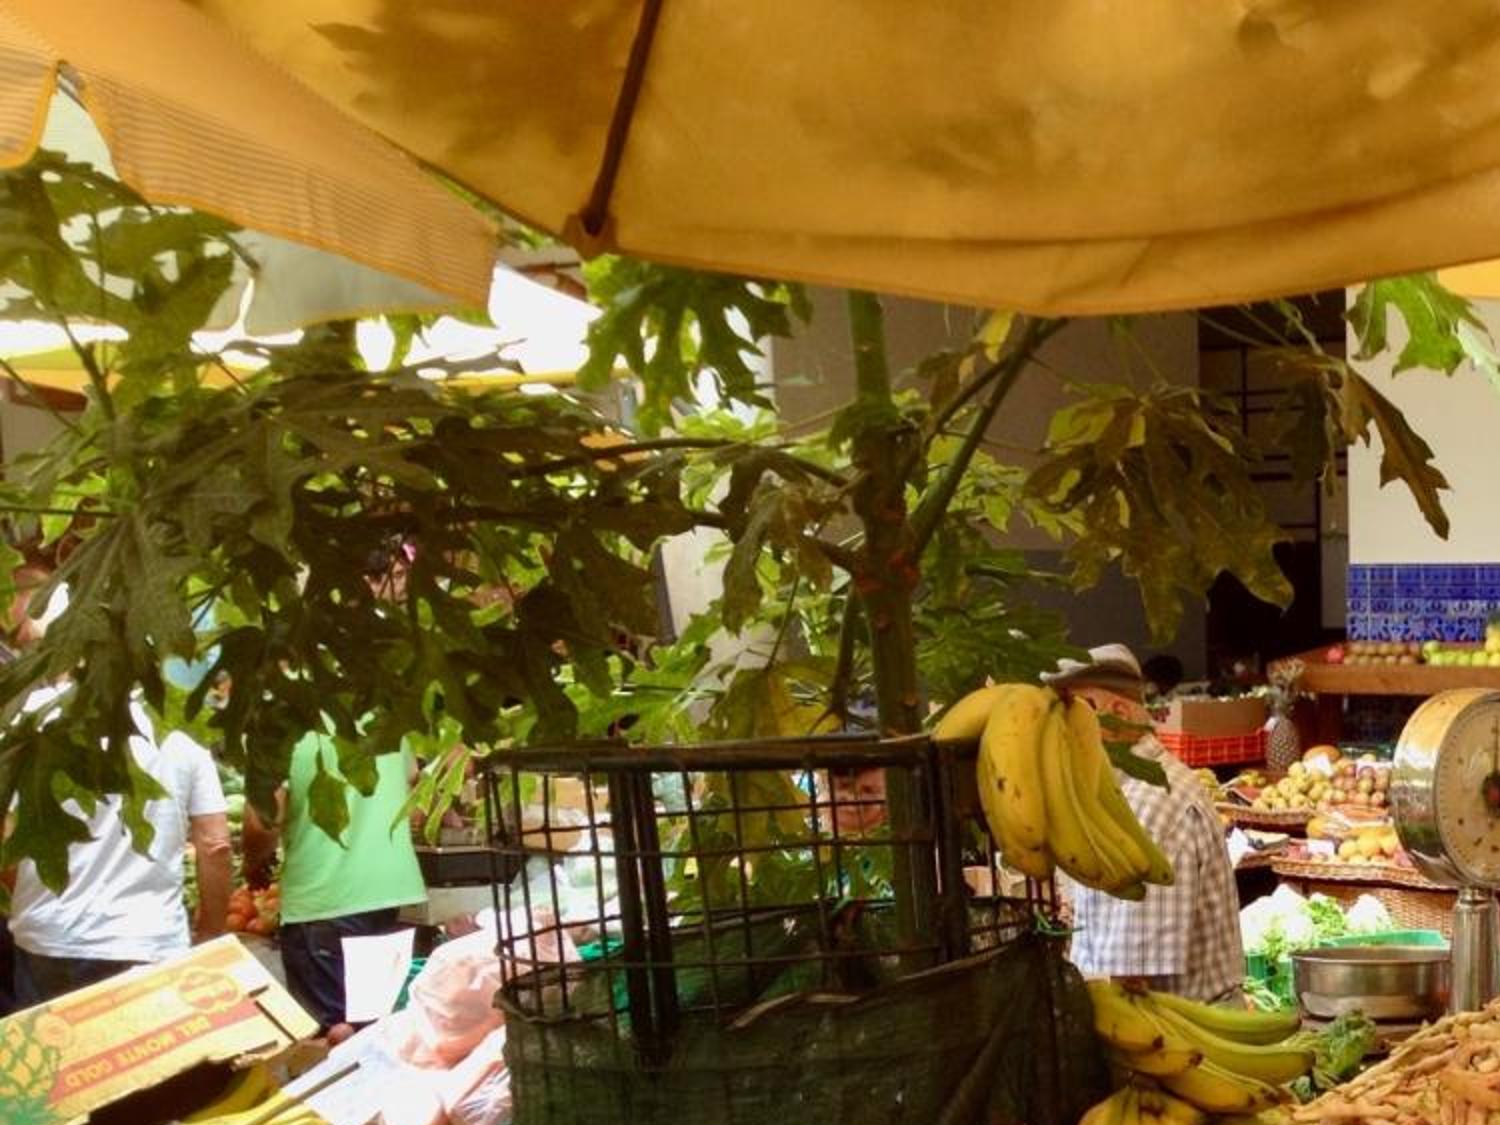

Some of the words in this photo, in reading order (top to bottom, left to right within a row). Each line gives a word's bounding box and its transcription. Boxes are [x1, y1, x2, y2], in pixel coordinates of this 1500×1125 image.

[179, 1015, 211, 1038] DEL
[120, 1033, 176, 1065] MONTE
[66, 1059, 112, 1088] GOLD
